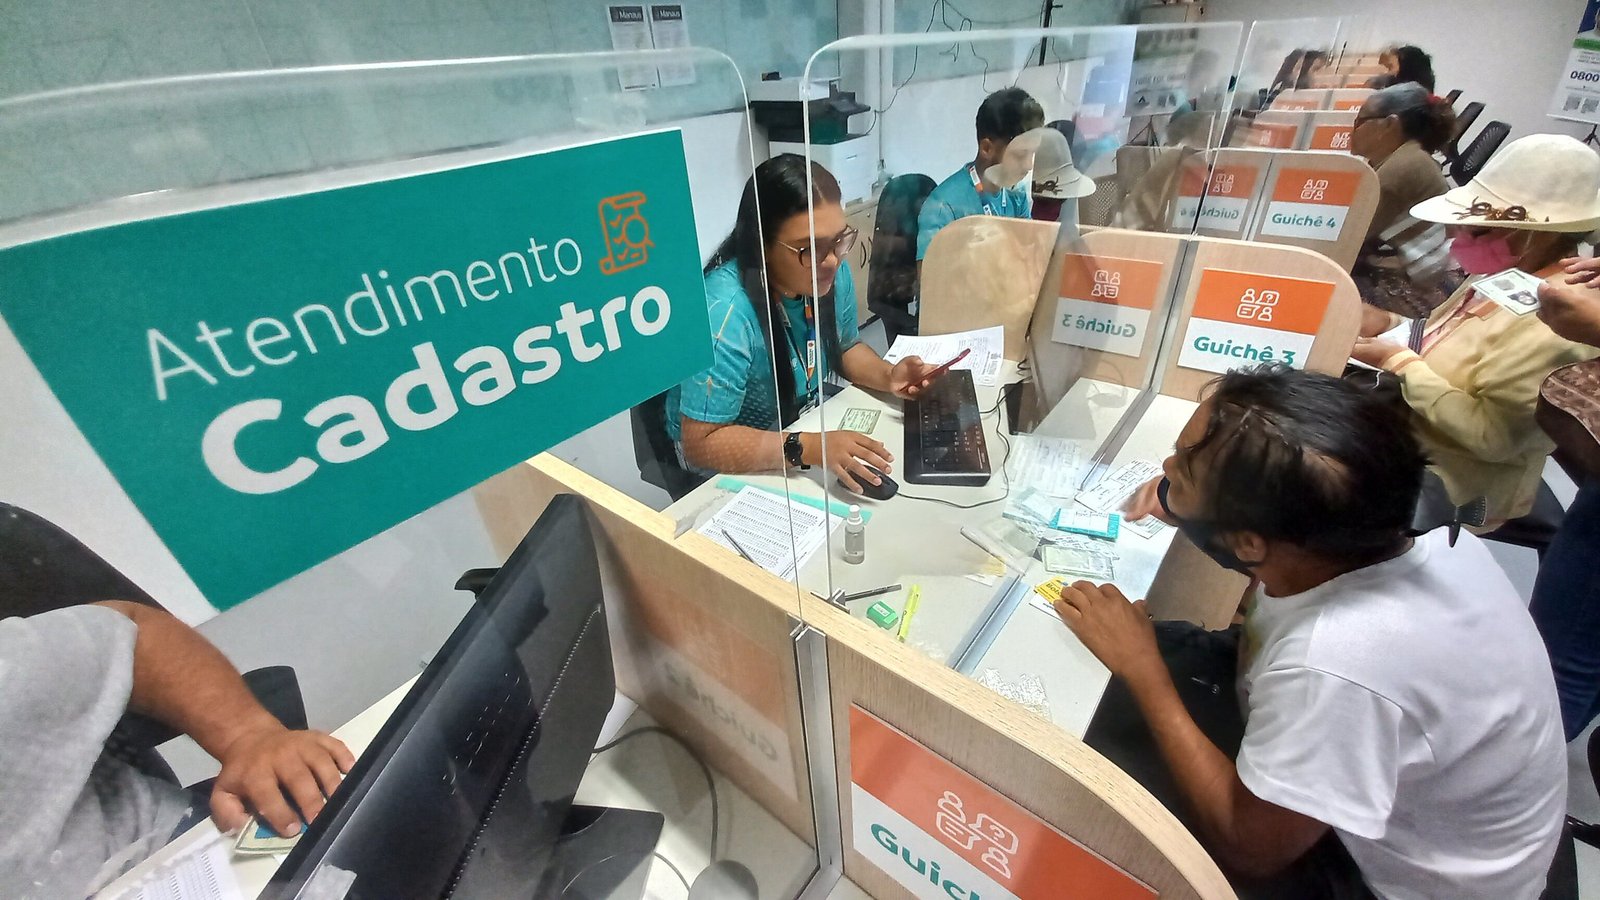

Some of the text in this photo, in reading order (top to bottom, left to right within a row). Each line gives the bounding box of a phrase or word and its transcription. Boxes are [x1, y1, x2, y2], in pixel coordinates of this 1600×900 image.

[619, 9, 642, 19] Manaus
[660, 10, 681, 18] Manaus
[1570, 70, 1600, 82] 0800
[1271, 212, 1336, 229] Guichê 4
[148, 237, 582, 400] Atendimento
[1193, 335, 1297, 366] Guichê 3
[201, 285, 671, 495] Cadastro
[870, 822, 982, 900] Guic
